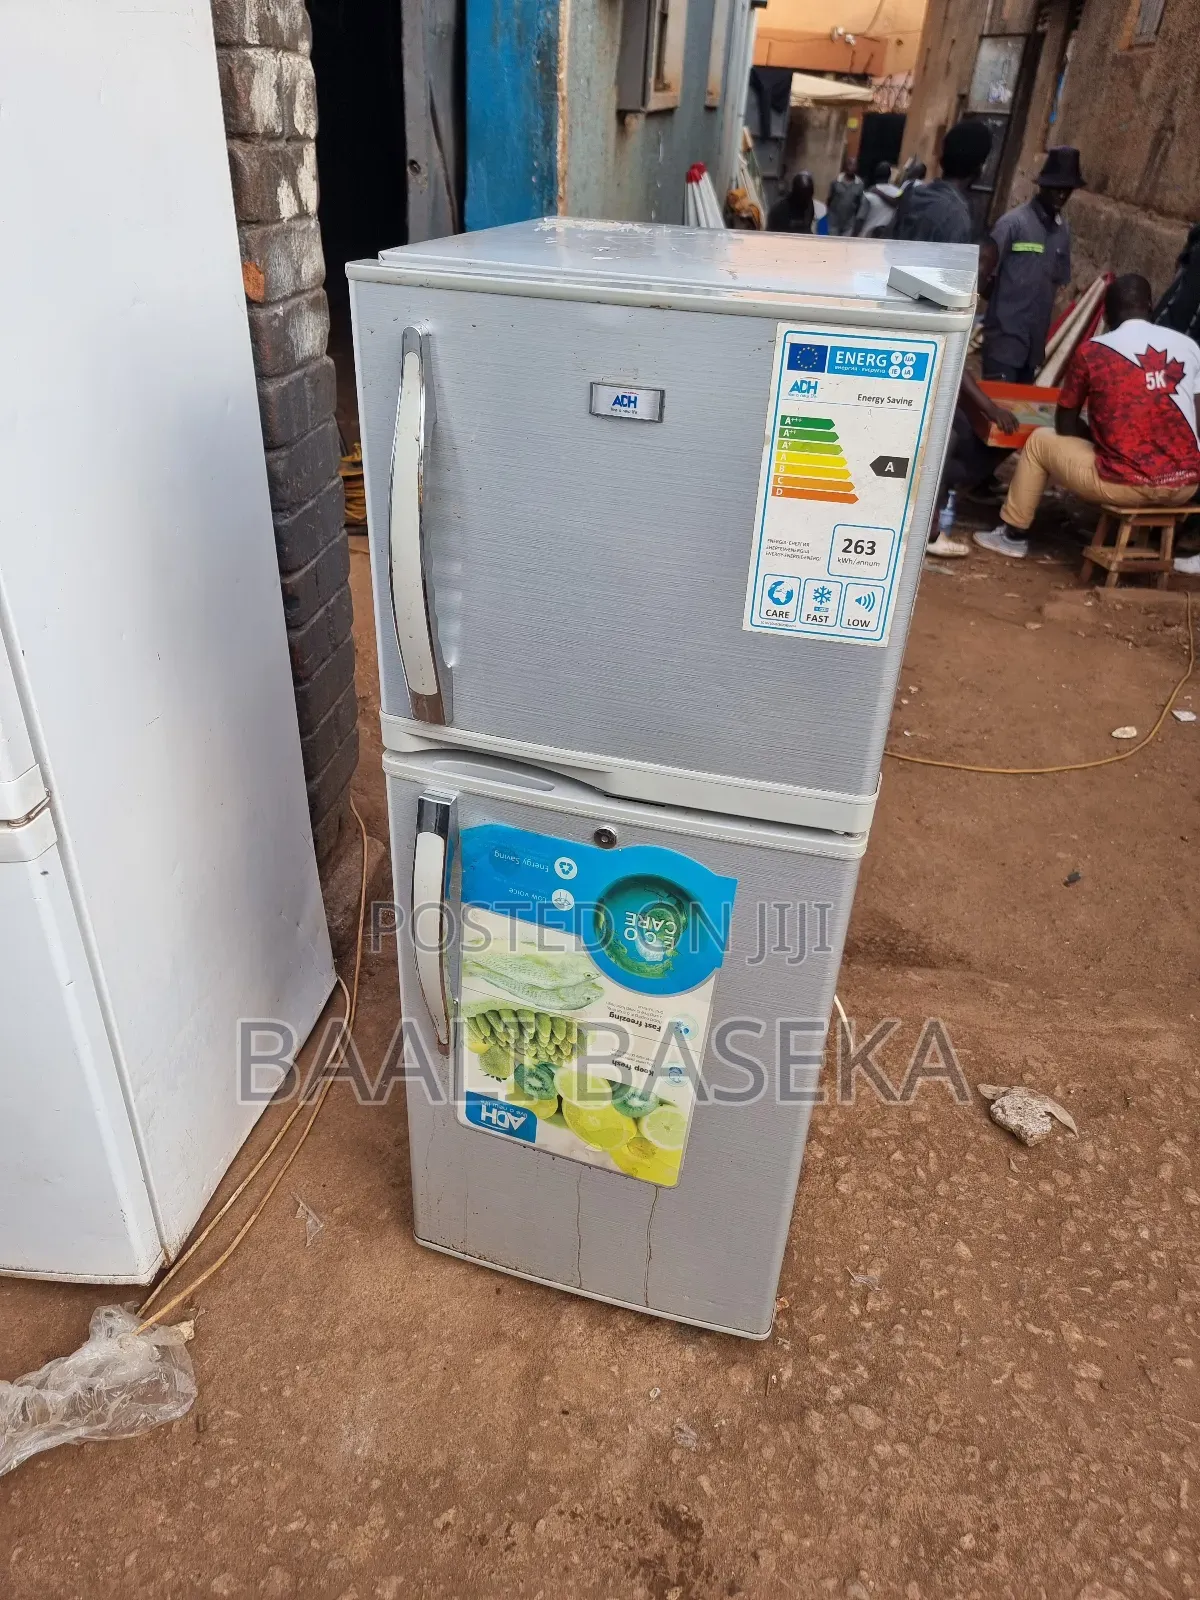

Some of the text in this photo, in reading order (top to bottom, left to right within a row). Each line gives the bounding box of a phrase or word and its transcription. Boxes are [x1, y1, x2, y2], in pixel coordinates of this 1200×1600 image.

[835, 350, 888, 367] ENERG
[789, 379, 819, 394] ADH
[1145, 370, 1167, 391] 5K
[612, 394, 638, 409] ADH
[857, 393, 914, 407] Energy Saving
[781, 441, 791, 449] A+
[780, 453, 787, 461] A
[779, 465, 785, 473] B
[884, 464, 895, 473] A
[775, 488, 783, 496] D
[841, 538, 876, 556] 263
[837, 556, 881, 567] kWh/annum
[765, 609, 790, 619] CARE
[806, 613, 829, 624] FAST
[847, 618, 871, 628] LOW
[494, 850, 520, 865] Saving
[523, 857, 549, 873] Energy
[508, 887, 547, 904] Low voice
[625, 911, 677, 935] CARE
[624, 927, 674, 950] ECO
[609, 1011, 662, 1032] Fast freezing
[612, 1059, 655, 1077] Keep fresh
[480, 1104, 527, 1130] ADH
